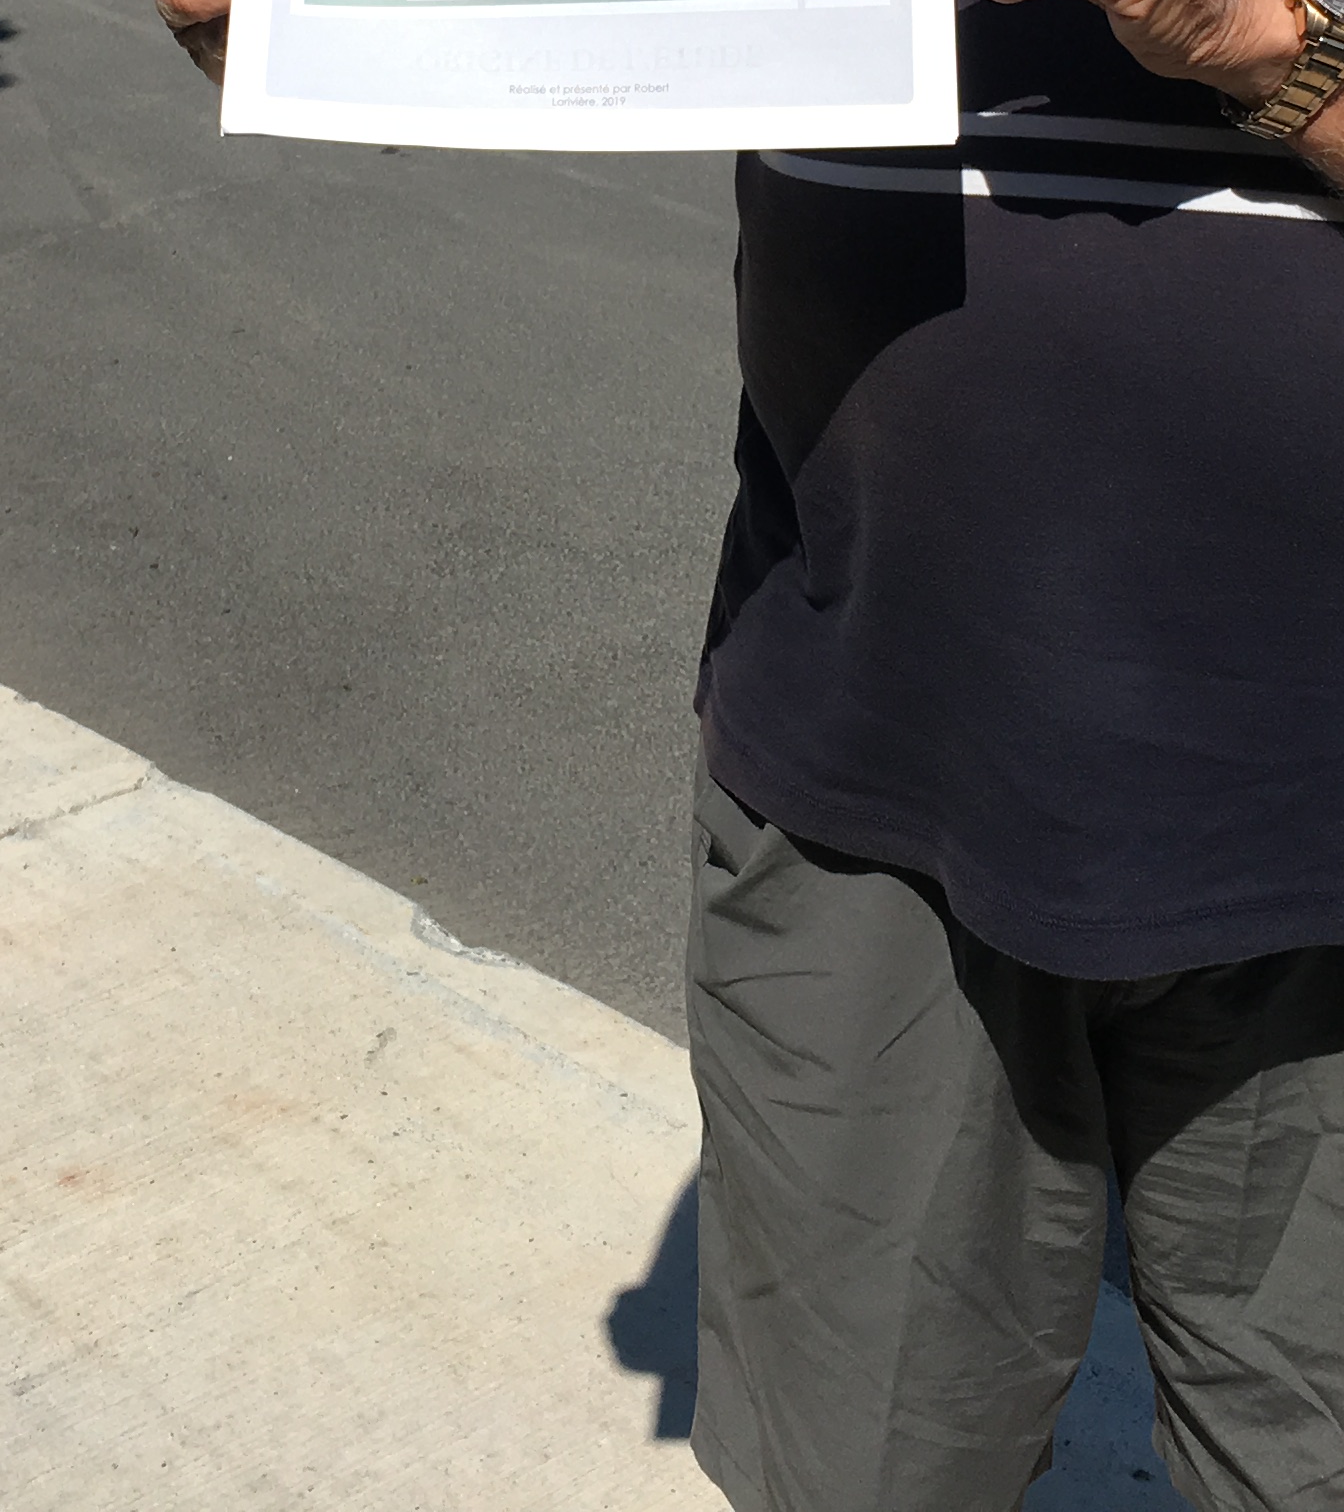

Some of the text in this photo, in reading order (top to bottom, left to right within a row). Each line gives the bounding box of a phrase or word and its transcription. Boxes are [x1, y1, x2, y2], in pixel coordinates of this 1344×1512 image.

[508, 83, 669, 96] Réalisé et présenté par Robert
[601, 96, 626, 106] 2019
